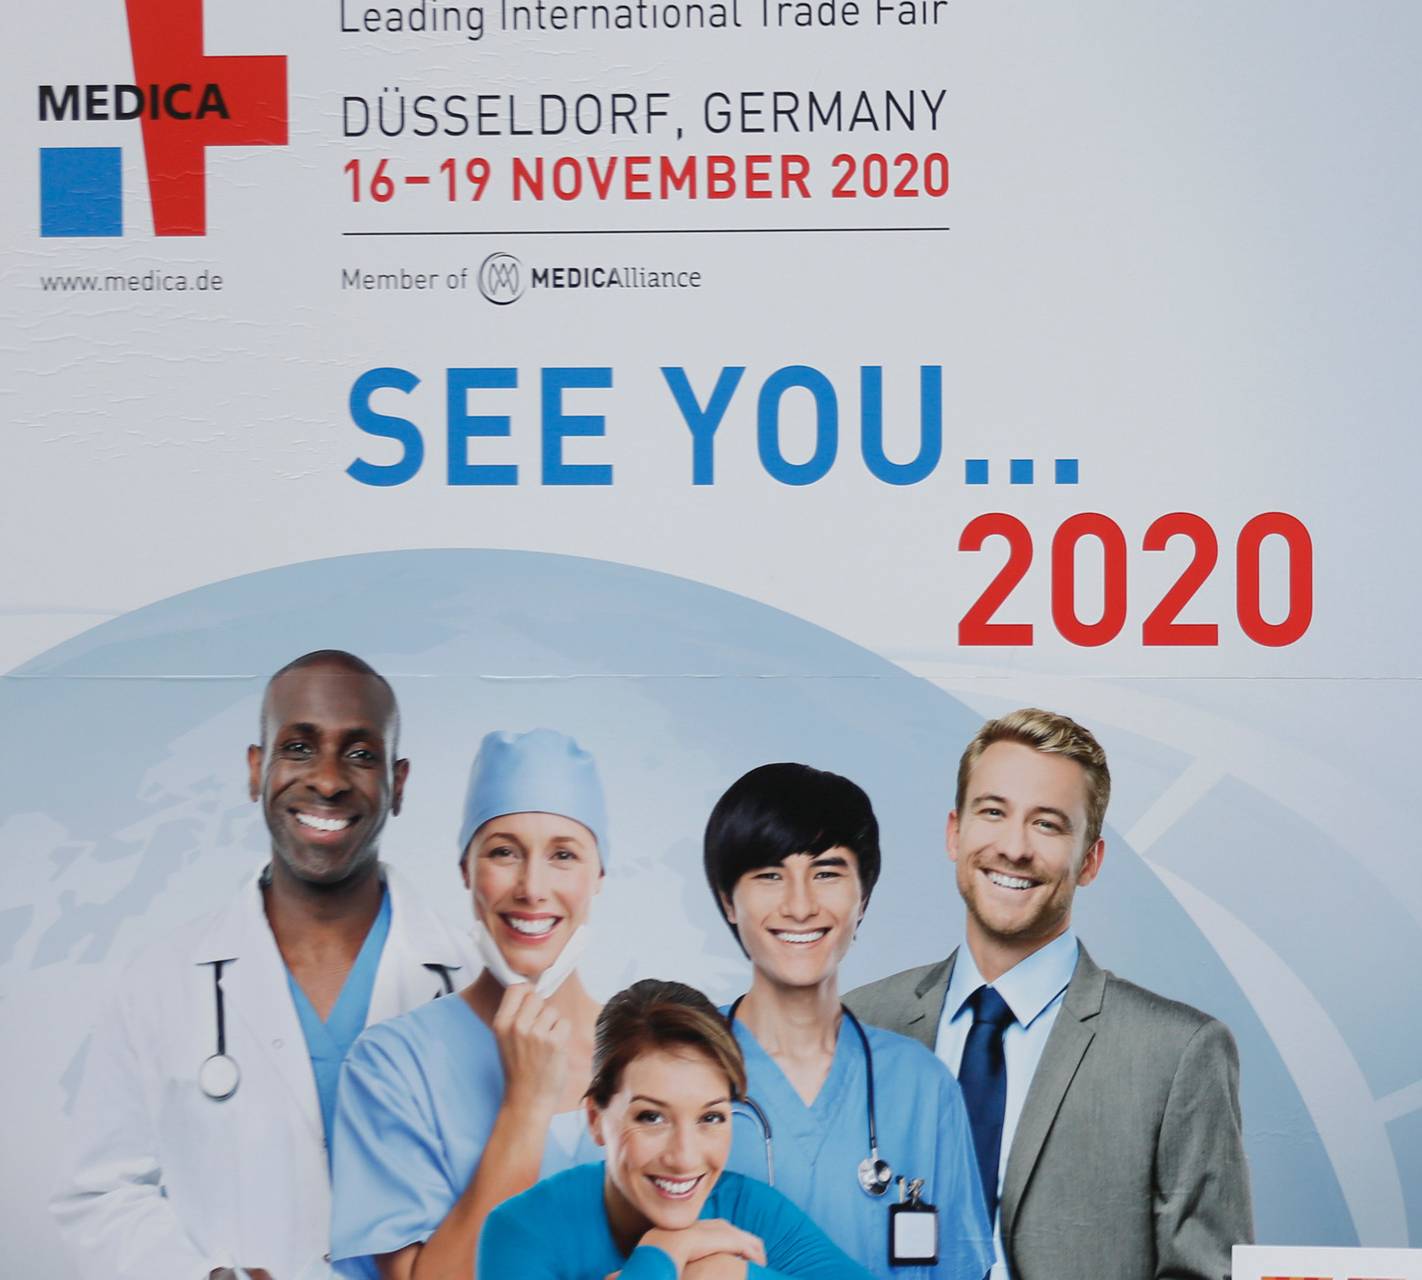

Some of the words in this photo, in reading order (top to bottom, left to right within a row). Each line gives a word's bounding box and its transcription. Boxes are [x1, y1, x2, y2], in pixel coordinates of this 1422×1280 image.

[340, 0, 484, 41] Leading
[501, 0, 742, 31] International
[761, 0, 860, 28] Trade
[876, 0, 949, 26] Fair
[38, 84, 230, 121] MEDICA
[342, 87, 683, 140] DÜSSELDORF,
[703, 90, 948, 134] GERMANY
[512, 155, 812, 202] NOVEMBER
[831, 152, 950, 200] 2020
[41, 270, 224, 293] www.medica.de
[341, 269, 437, 290] Member
[446, 267, 469, 290] of
[531, 266, 702, 289] MEDICAlliance
[346, 367, 614, 488] SEE
[660, 365, 1081, 487] YOU...
[958, 511, 1313, 648] 2020
